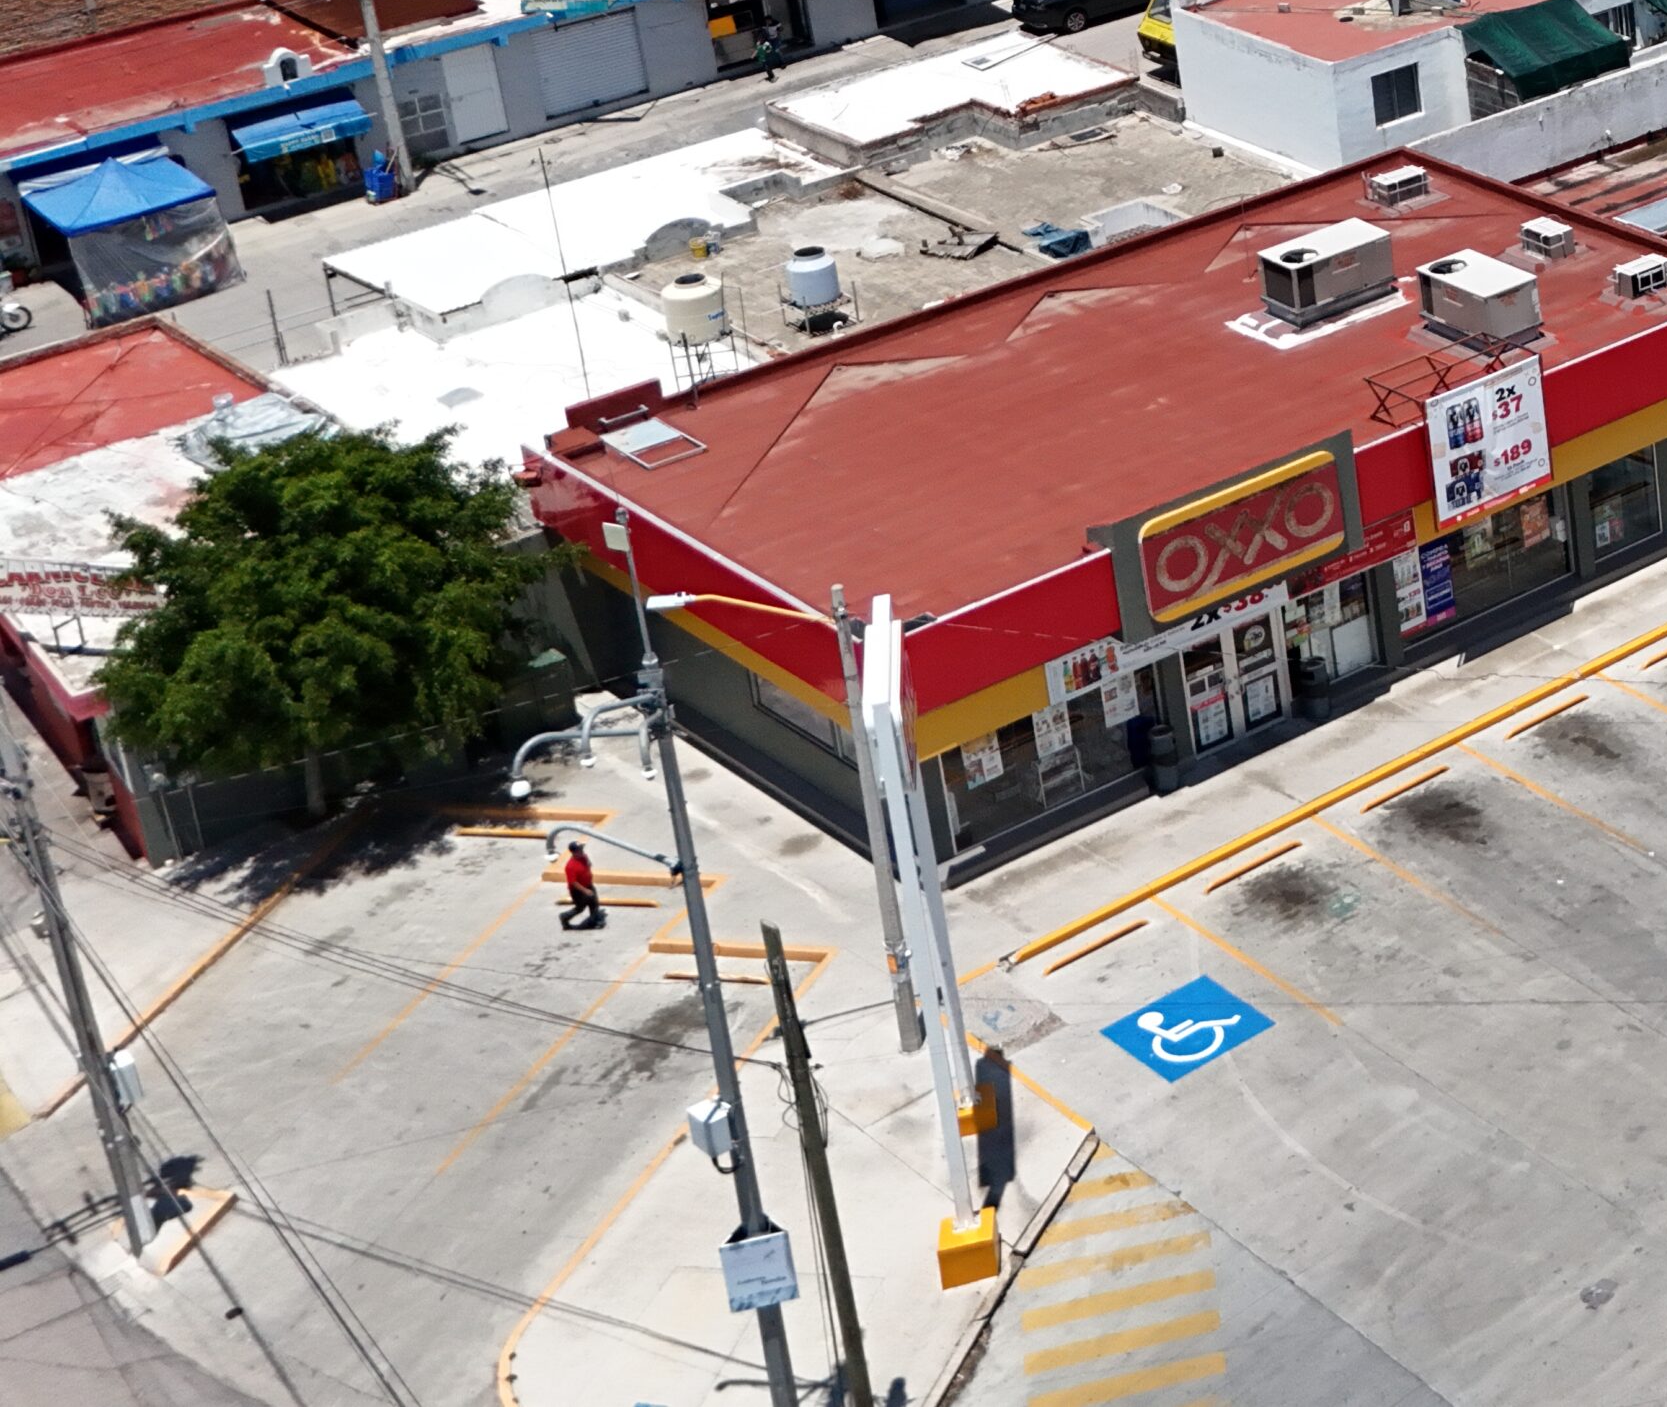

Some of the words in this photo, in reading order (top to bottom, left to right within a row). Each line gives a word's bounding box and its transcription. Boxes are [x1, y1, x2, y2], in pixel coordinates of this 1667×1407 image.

[1492, 394, 1523, 421] $37
[1494, 438, 1532, 467] $189
[1156, 482, 1335, 600] OXXO
